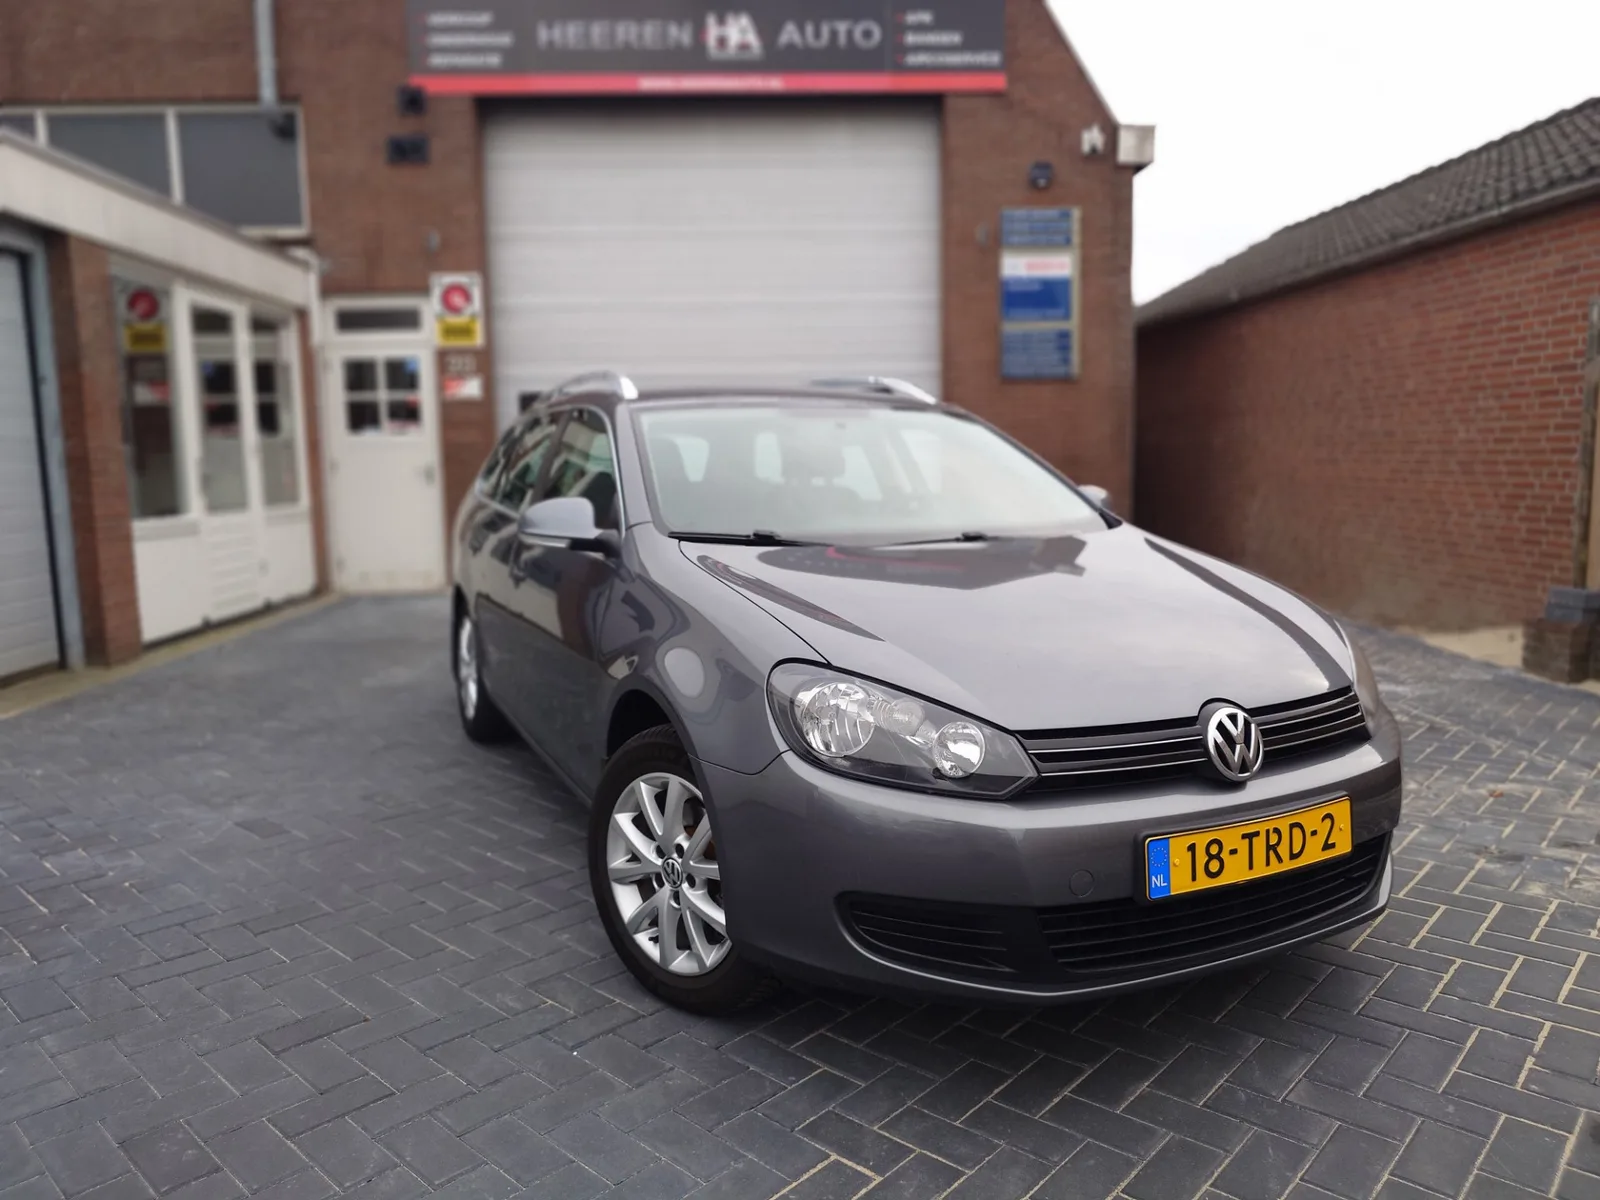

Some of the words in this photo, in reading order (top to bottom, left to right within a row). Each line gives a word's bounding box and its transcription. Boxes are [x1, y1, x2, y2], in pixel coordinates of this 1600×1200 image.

[537, 20, 693, 49] HEEREN
[777, 19, 882, 48] AUTO
[1186, 812, 1337, 882] 18-TRD-2
[1151, 873, 1168, 889] NL
